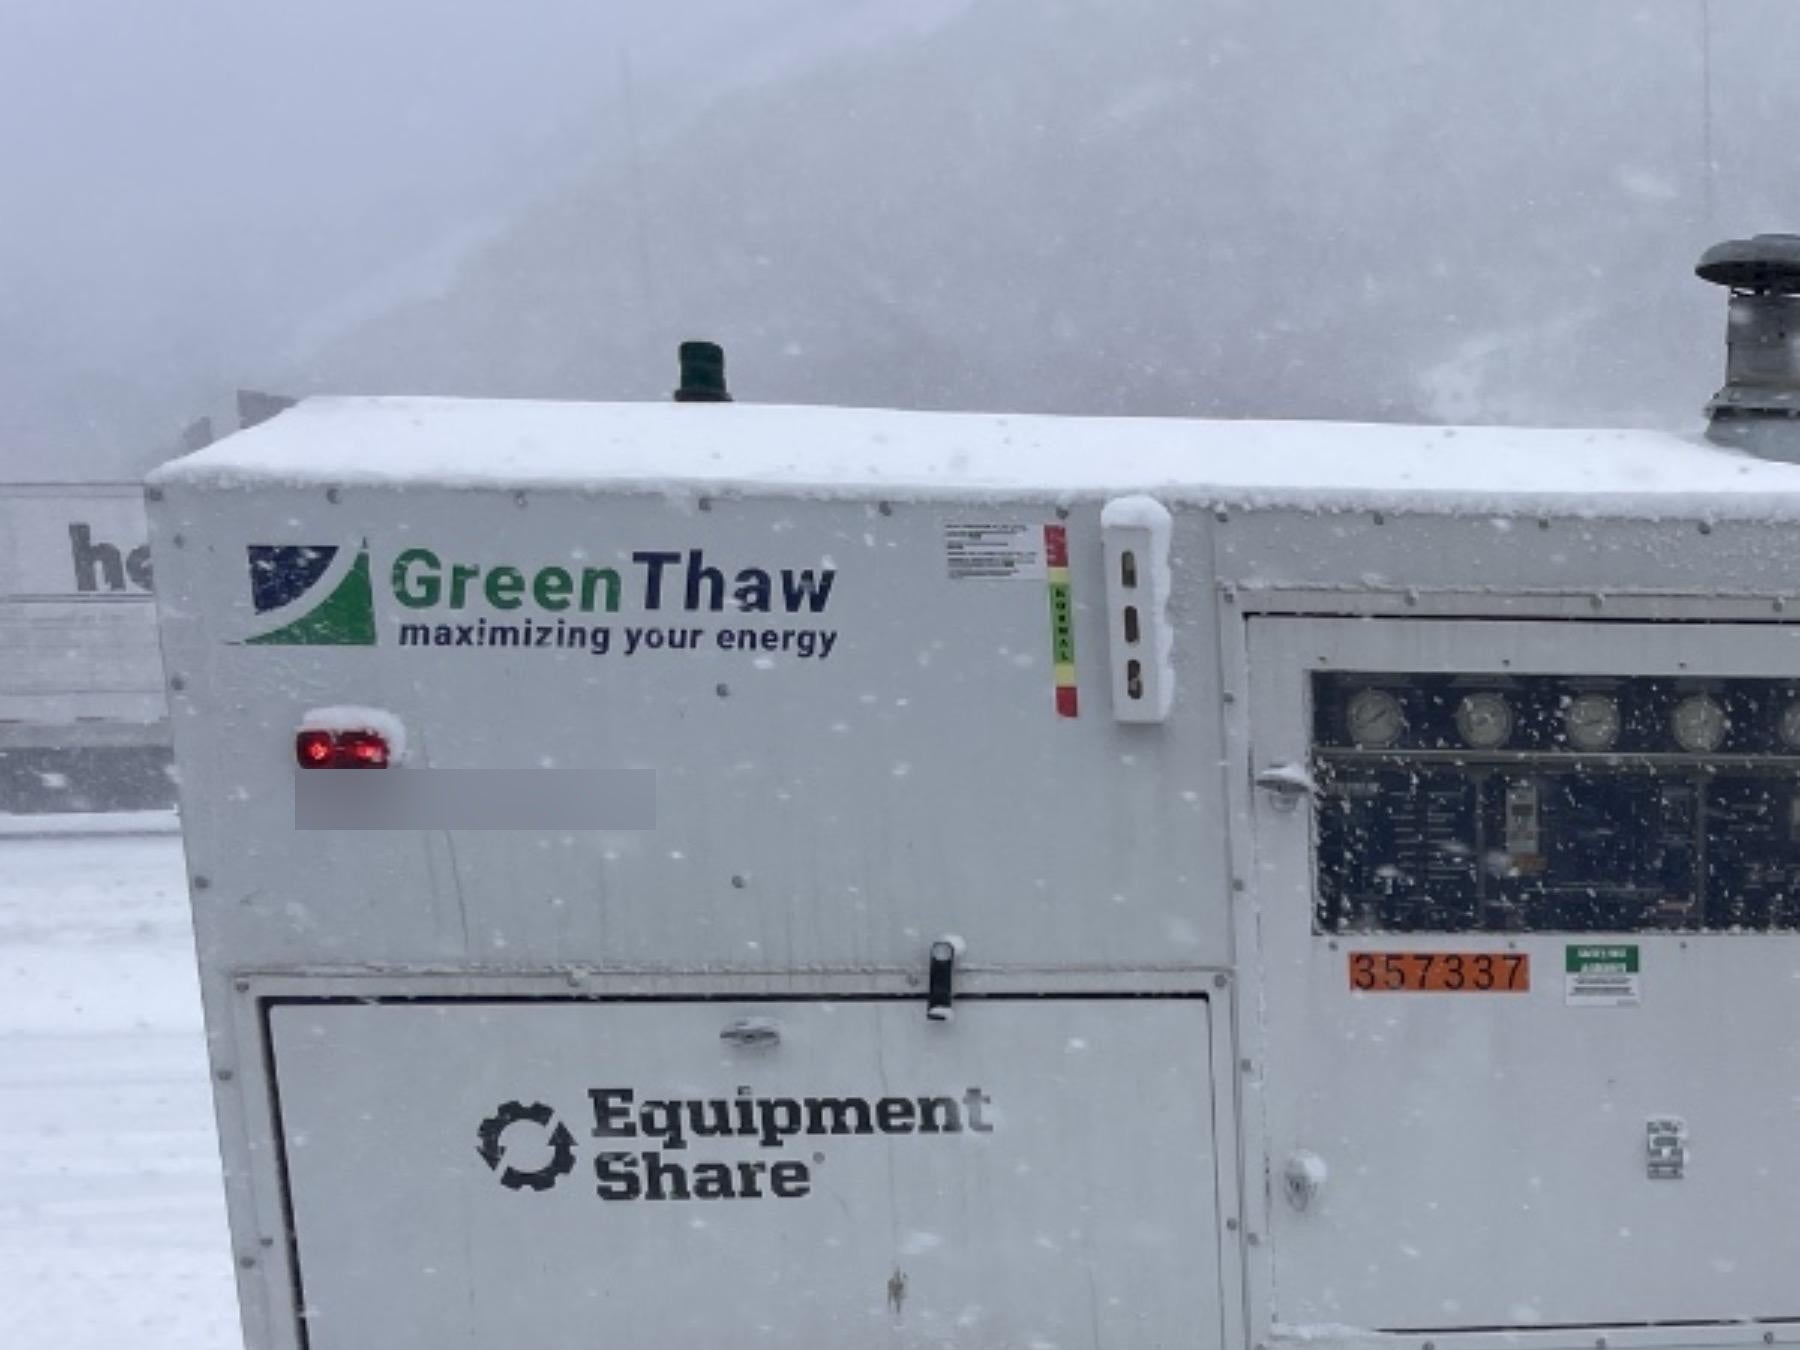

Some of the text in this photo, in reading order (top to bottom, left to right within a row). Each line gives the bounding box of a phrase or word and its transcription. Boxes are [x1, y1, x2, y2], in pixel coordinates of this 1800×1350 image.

[399, 616, 839, 661] maximizing your energy
[1354, 953, 1524, 991] 357337
[588, 1085, 996, 1149] Equipment
[593, 1151, 812, 1201] Share
